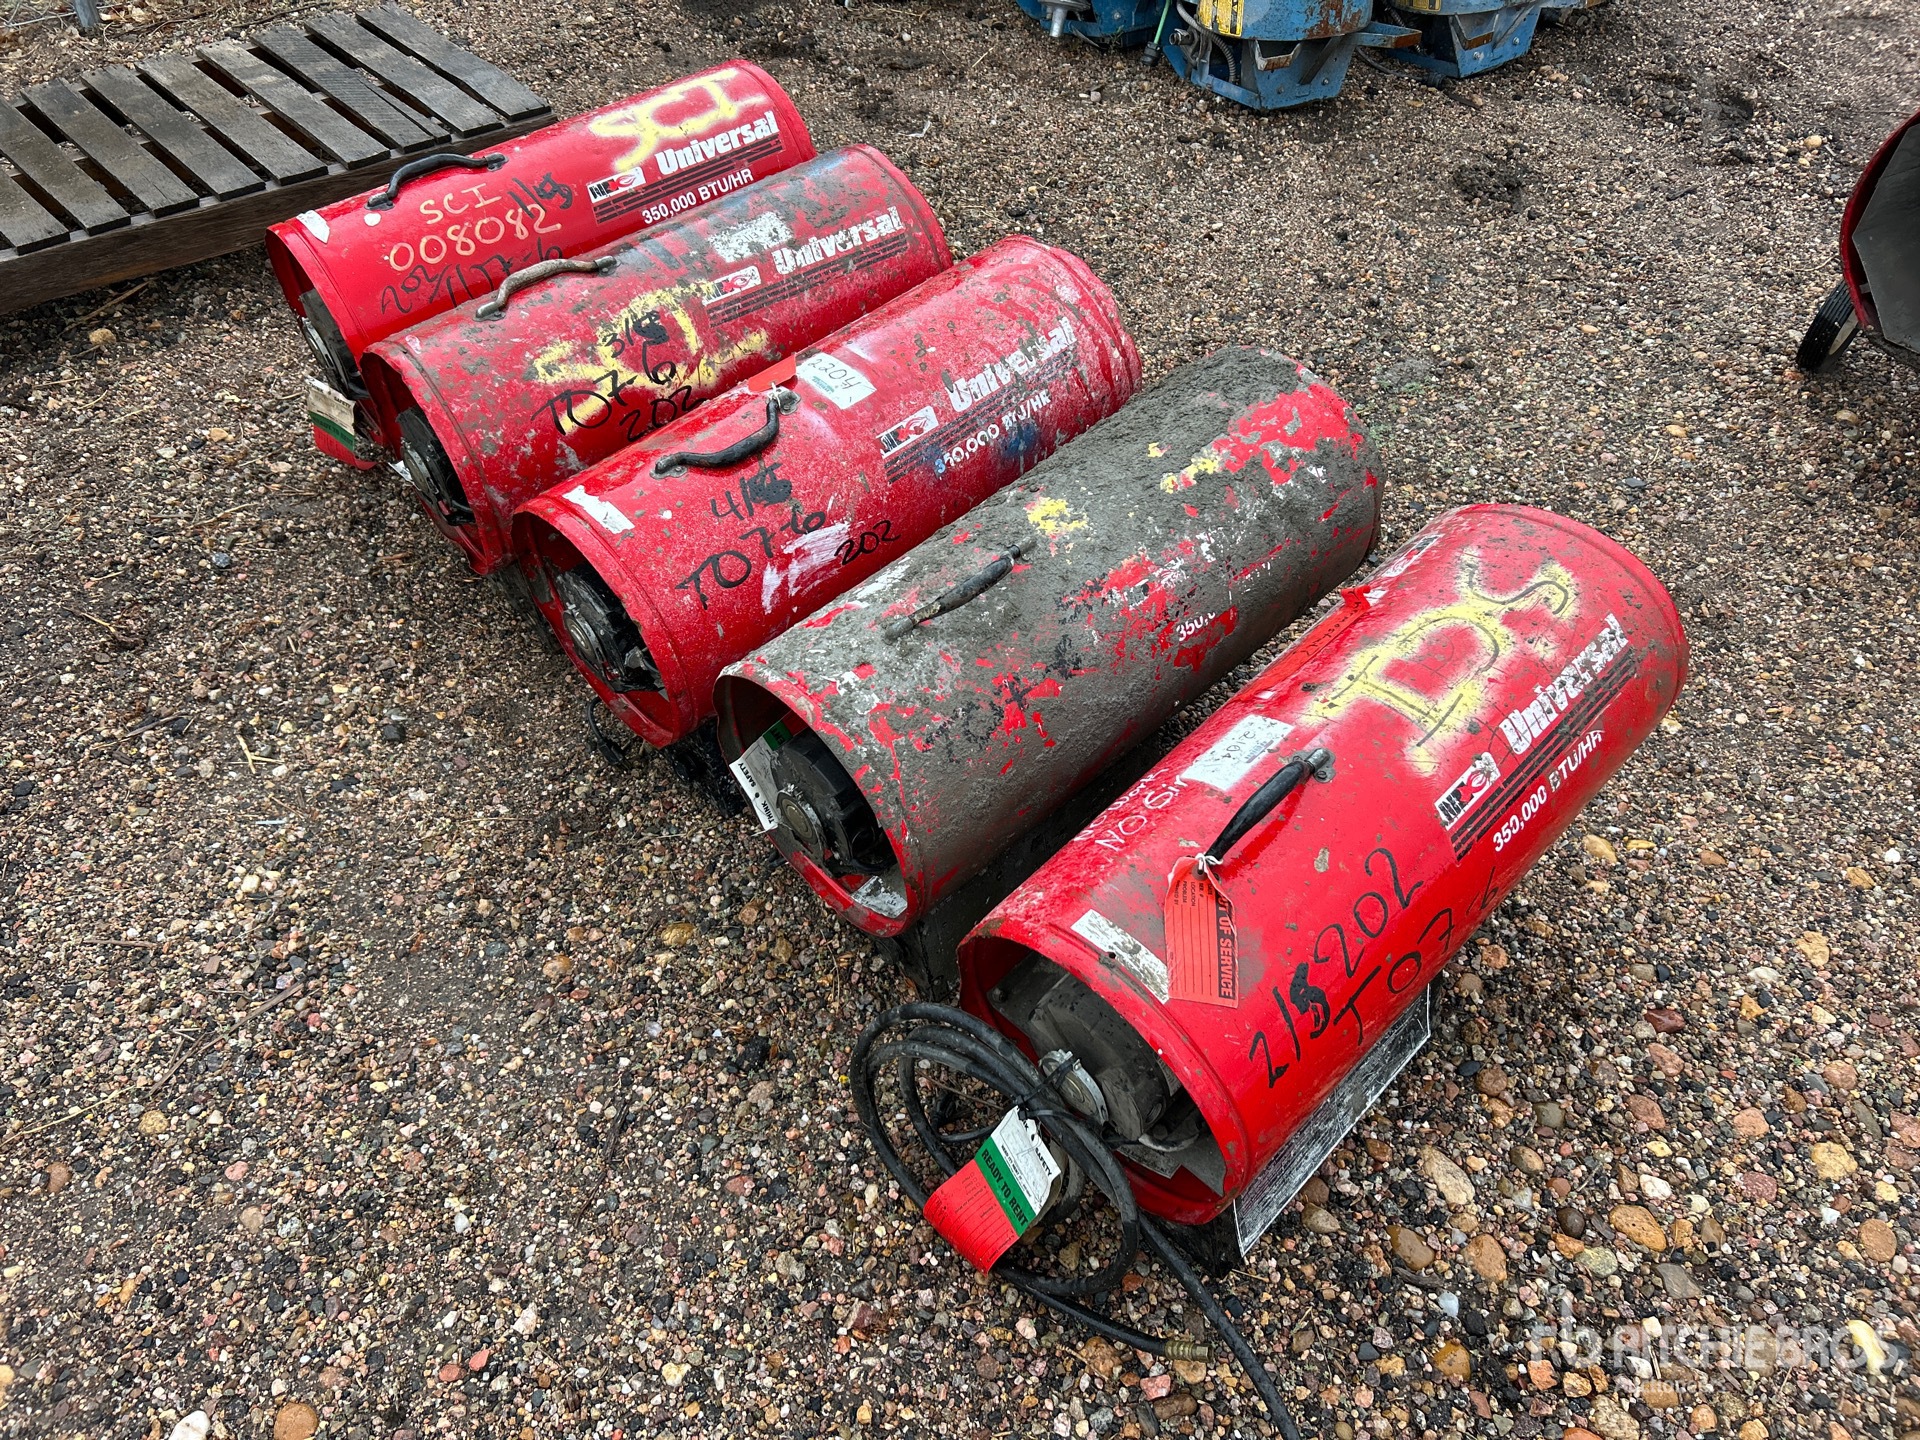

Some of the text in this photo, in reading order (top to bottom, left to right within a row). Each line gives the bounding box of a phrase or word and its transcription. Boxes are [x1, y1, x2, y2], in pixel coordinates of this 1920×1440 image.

[653, 110, 780, 176] Universal
[419, 183, 502, 225] SCI
[641, 168, 755, 225] 350,000 BTU/HR
[389, 204, 562, 271] 008082
[771, 205, 904, 275] Universal
[807, 358, 861, 390] 2204
[945, 316, 1078, 413] Universal
[618, 384, 707, 443] 202
[934, 423, 1000, 474] 350,000
[834, 519, 901, 567] 202
[1498, 613, 1630, 755] Universal
[737, 761, 776, 824] THINK SAFETY
[1492, 785, 1548, 853] 350,000
[1313, 847, 1425, 979] 202
[1219, 937, 1236, 999] SERVICE
[981, 1149, 1004, 1181] READY
[1000, 1181, 1012, 1199] TO
[1008, 1198, 1029, 1227] RENT
